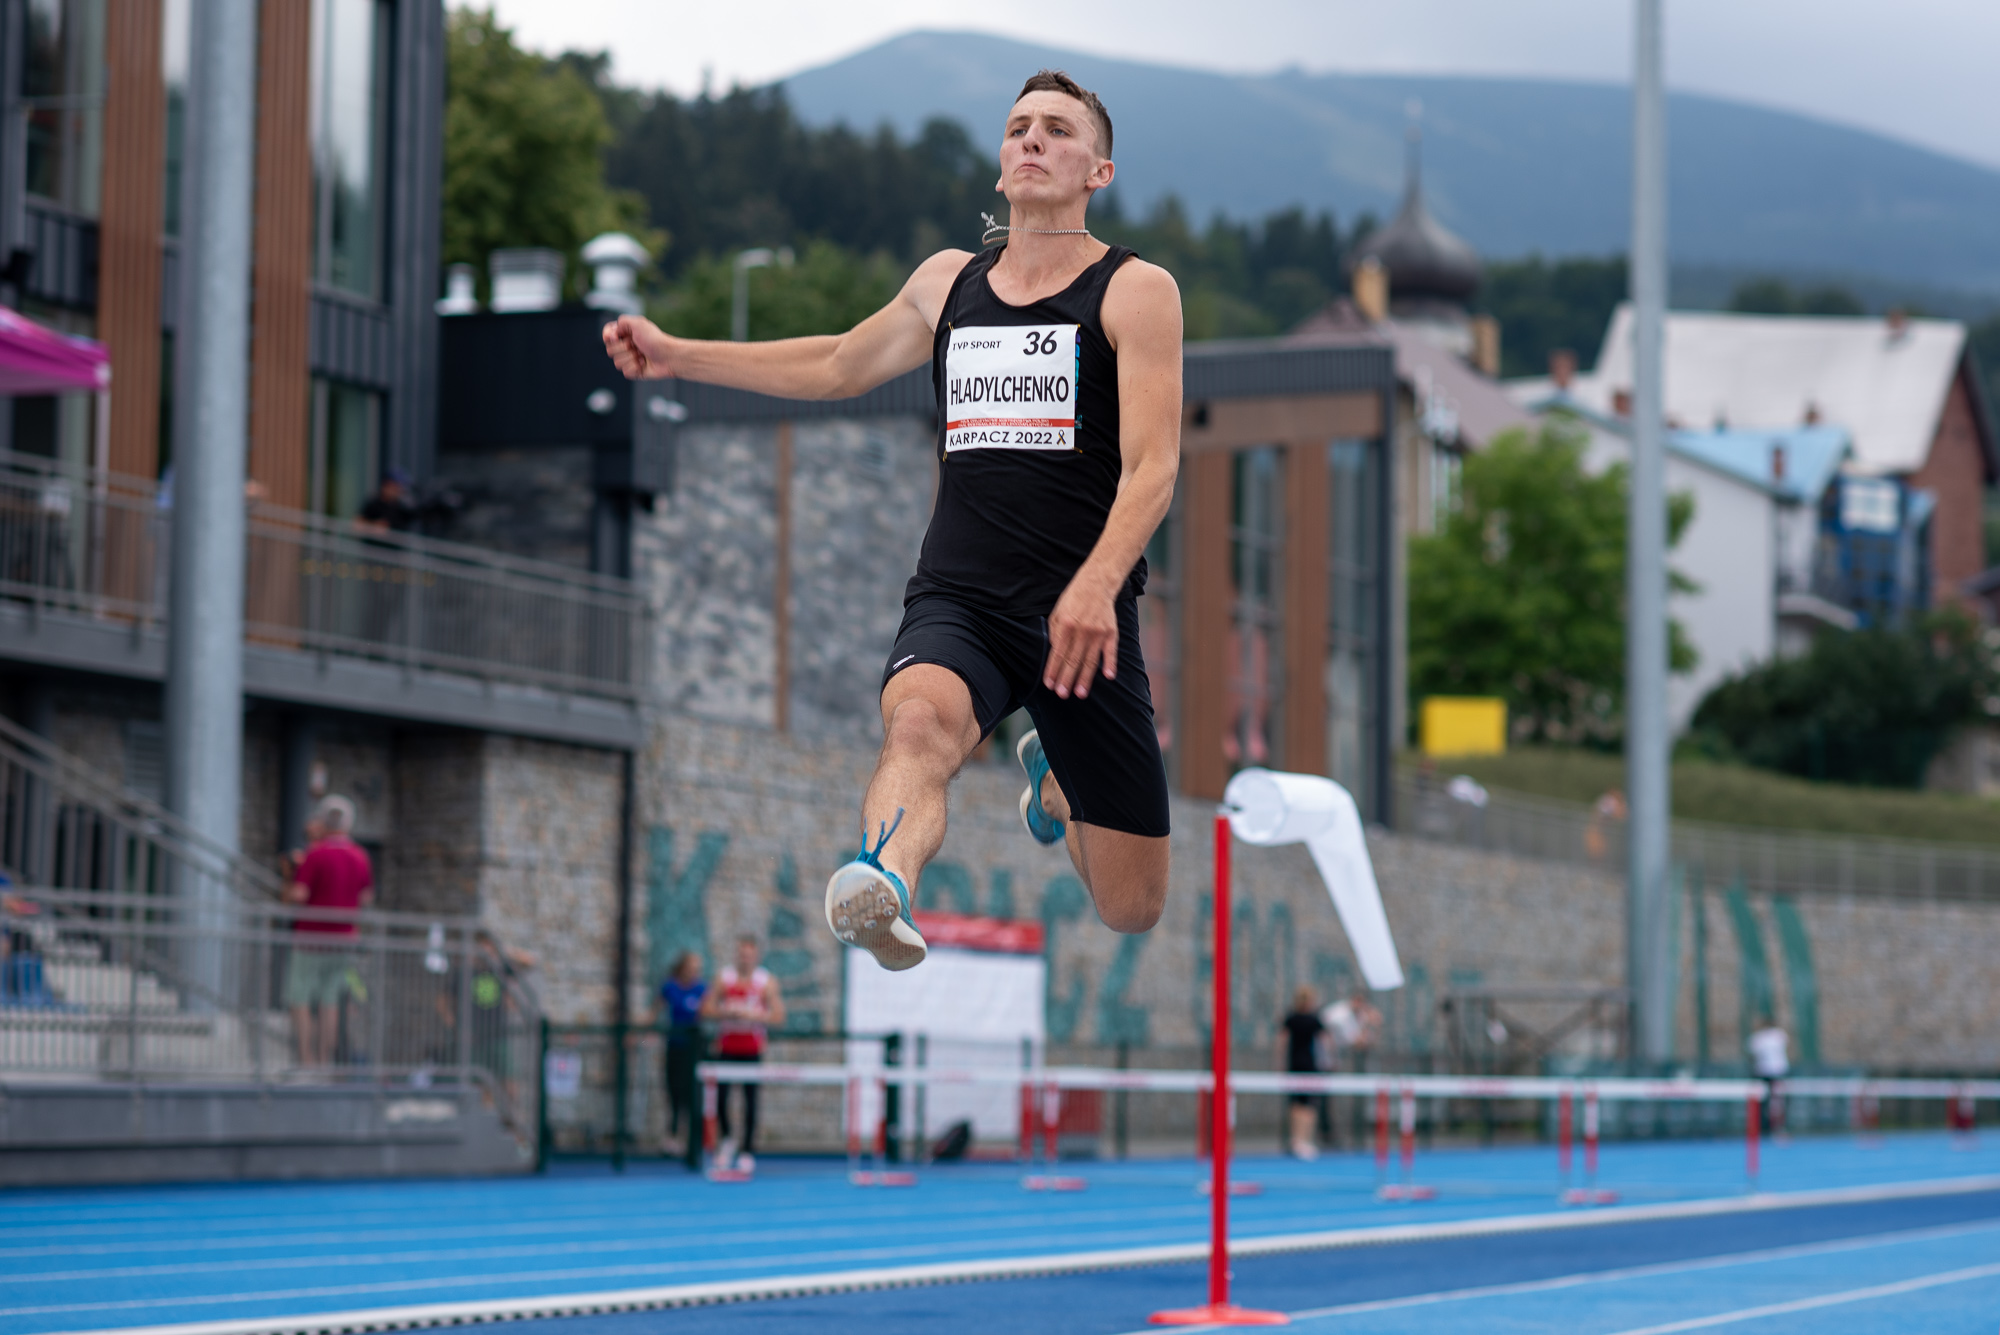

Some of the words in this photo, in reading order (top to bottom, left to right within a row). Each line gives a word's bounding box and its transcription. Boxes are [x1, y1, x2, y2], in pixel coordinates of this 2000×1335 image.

[952, 342, 968, 351] TVP
[970, 340, 1002, 350] SPORT
[1023, 330, 1057, 355] 36
[950, 376, 1069, 405] HLADYLCHENKO
[949, 430, 1010, 446] KARPACZ
[1014, 431, 1053, 444] 2022
